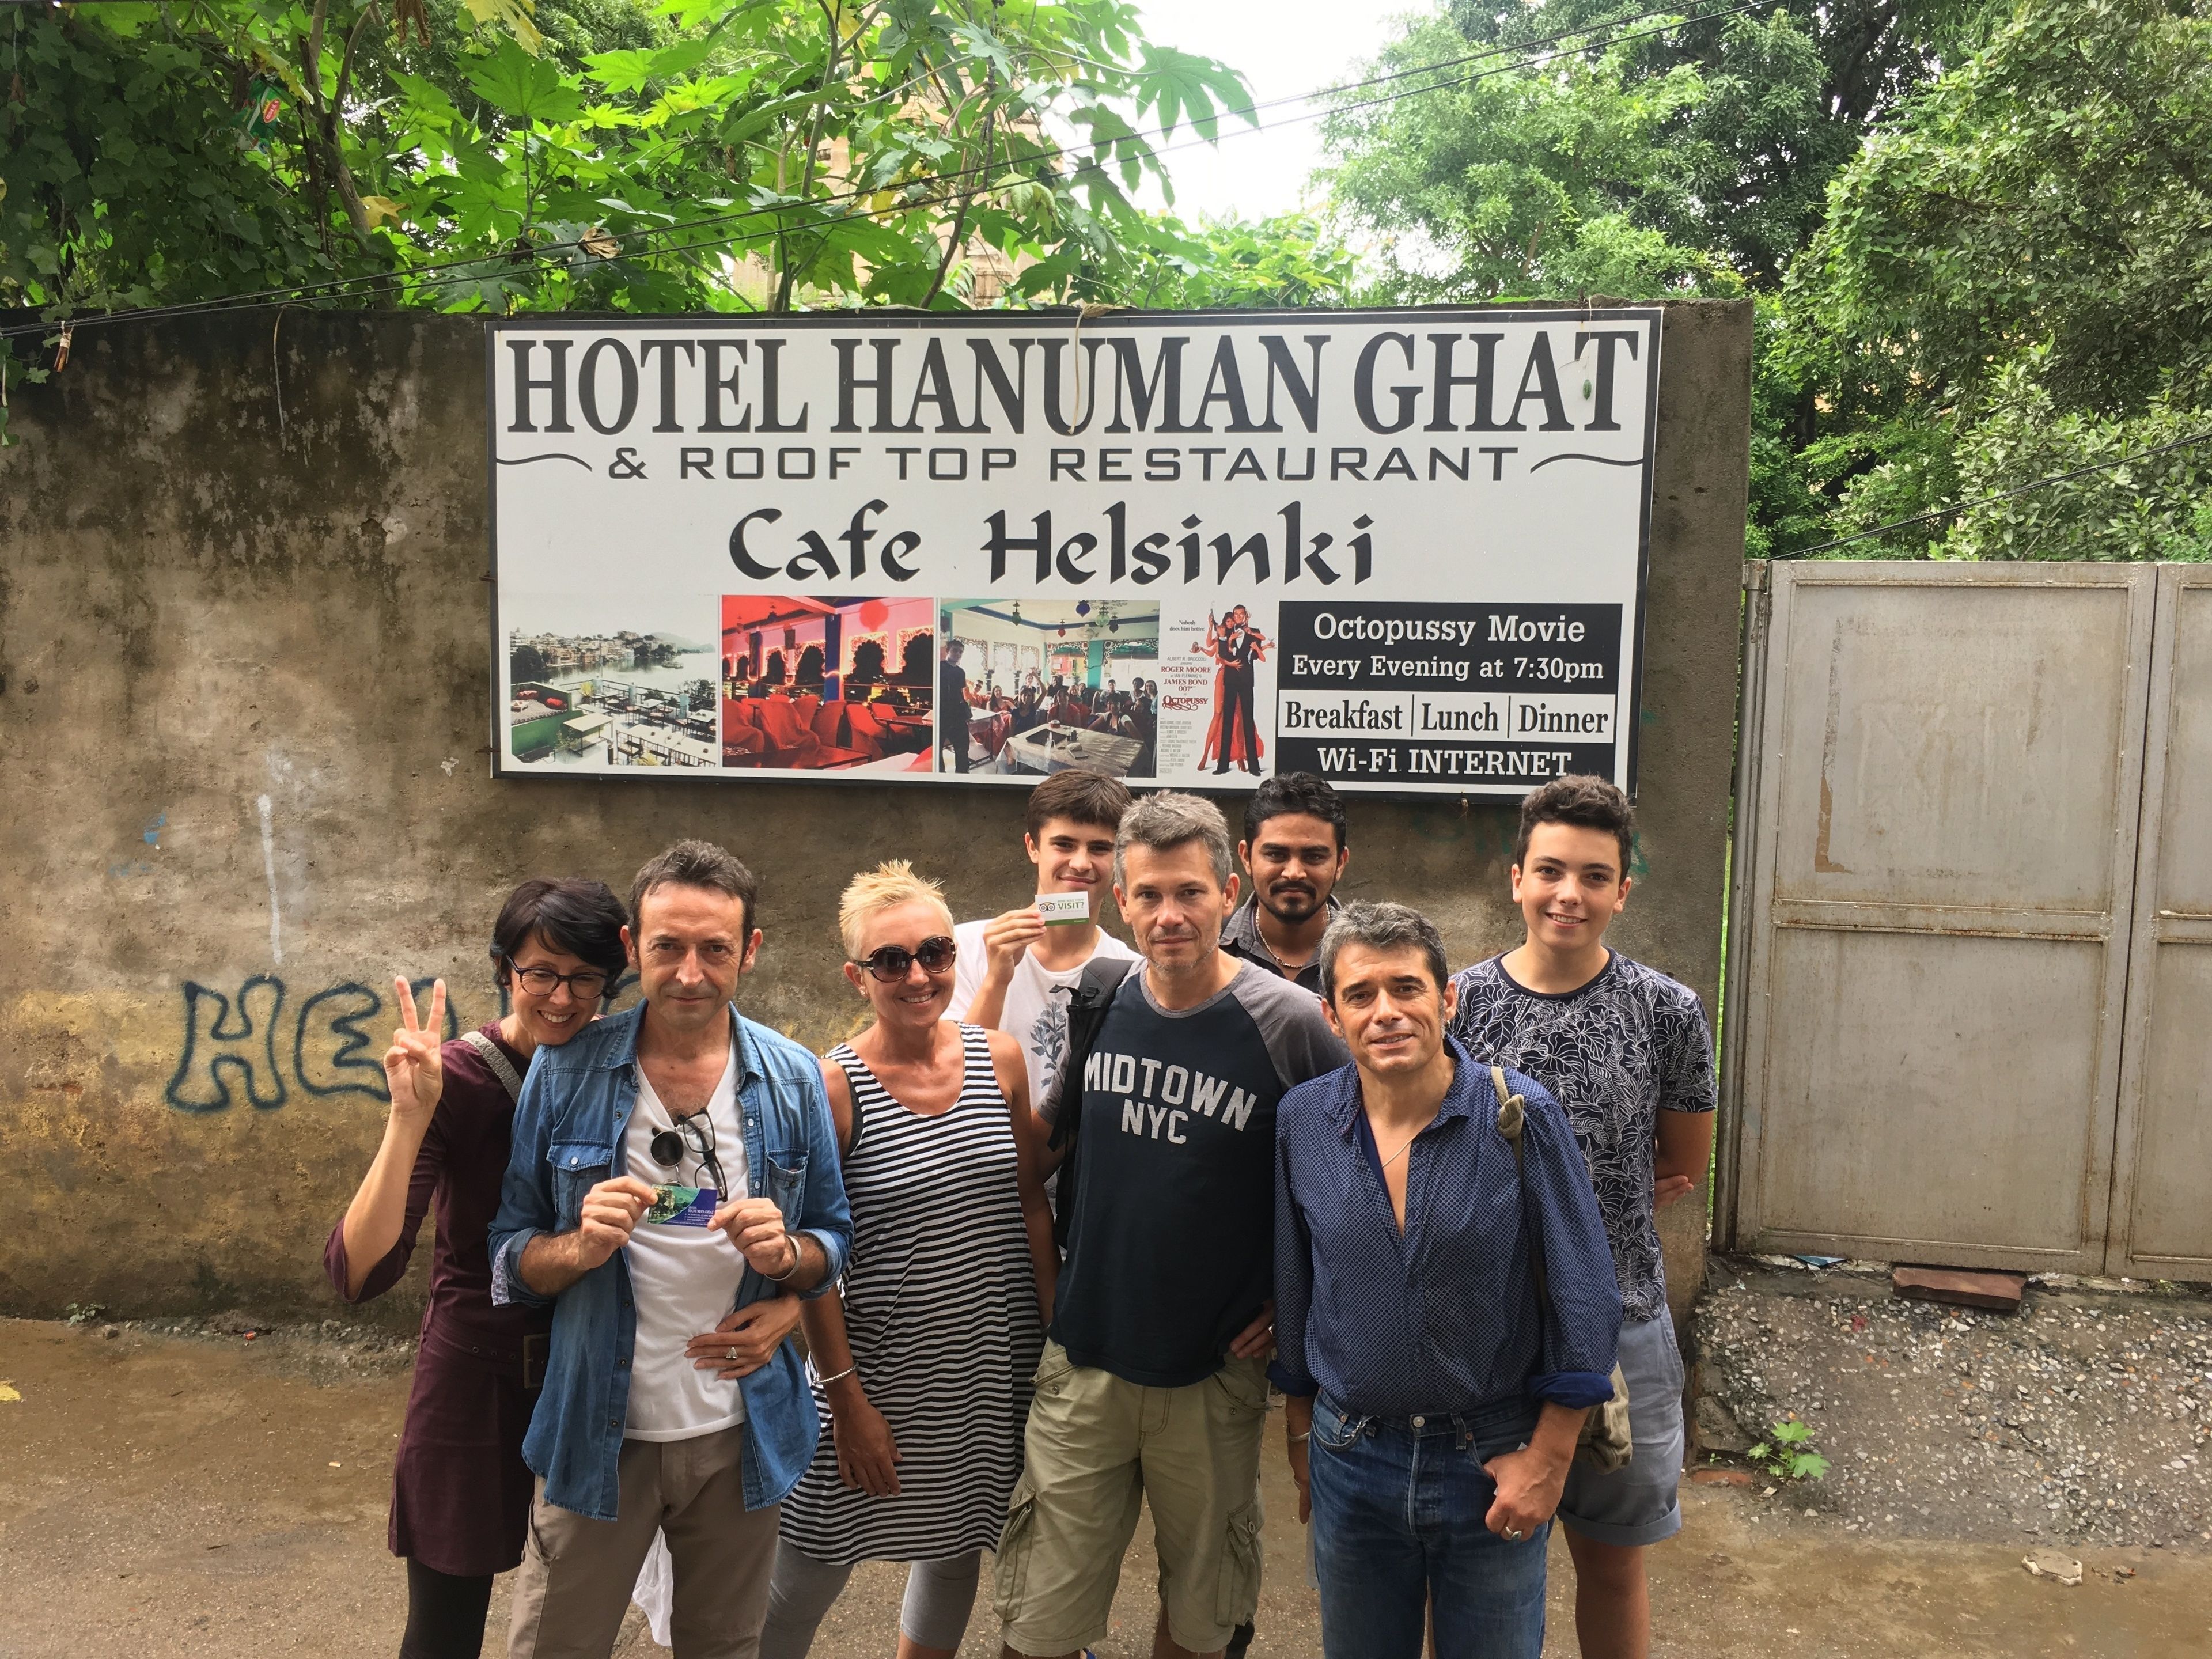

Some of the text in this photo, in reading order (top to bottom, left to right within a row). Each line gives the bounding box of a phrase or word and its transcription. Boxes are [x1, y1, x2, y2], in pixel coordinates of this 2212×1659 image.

[506, 331, 1638, 437] HOTEL HANUMAN GHAT
[609, 447, 1518, 482] & ROOF TOP RESTAURANT
[729, 499, 1374, 586] Cafe Helsinki
[1314, 613, 1585, 646] Octopussy Movie
[1292, 654, 1604, 683] Every Evening at 7:30pm
[1285, 699, 1609, 734] Breakfast Lunch Dinner
[1317, 747, 1572, 777] Wi-Fi INTERNET
[1058, 902, 1084, 910] VISIT?
[1084, 1051, 1257, 1132] MIDTOWN
[1121, 1099, 1189, 1145] NYC
